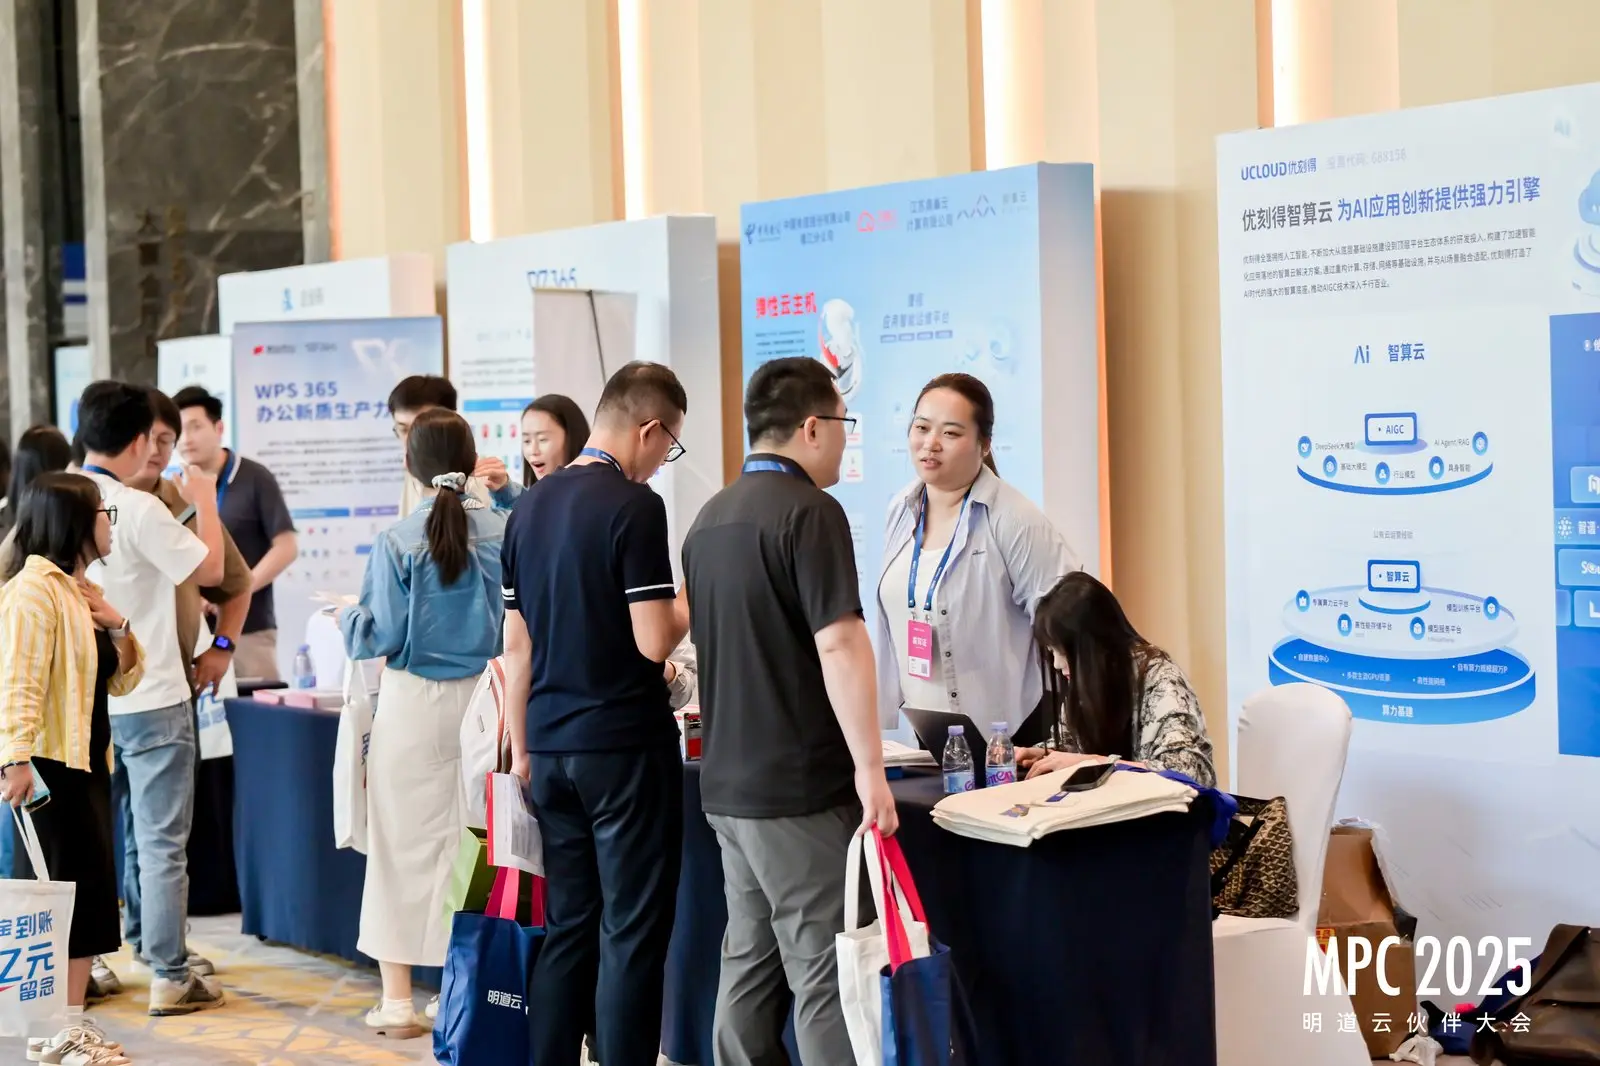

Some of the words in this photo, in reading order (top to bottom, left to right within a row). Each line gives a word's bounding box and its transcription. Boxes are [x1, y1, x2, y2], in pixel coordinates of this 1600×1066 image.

[1242, 201, 1333, 232] 优刻得智算云
[1337, 176, 1541, 222] 为AI应用创新提供强力引擎
[755, 292, 817, 319] 弹性云主机
[1388, 343, 1425, 362] 智算云
[254, 382, 298, 399] WPS
[304, 381, 338, 398] 365
[1386, 424, 1404, 435] AIGC
[1386, 570, 1411, 583] 智算云
[19, 975, 55, 1002] 留念
[488, 989, 522, 1009] 明道云
